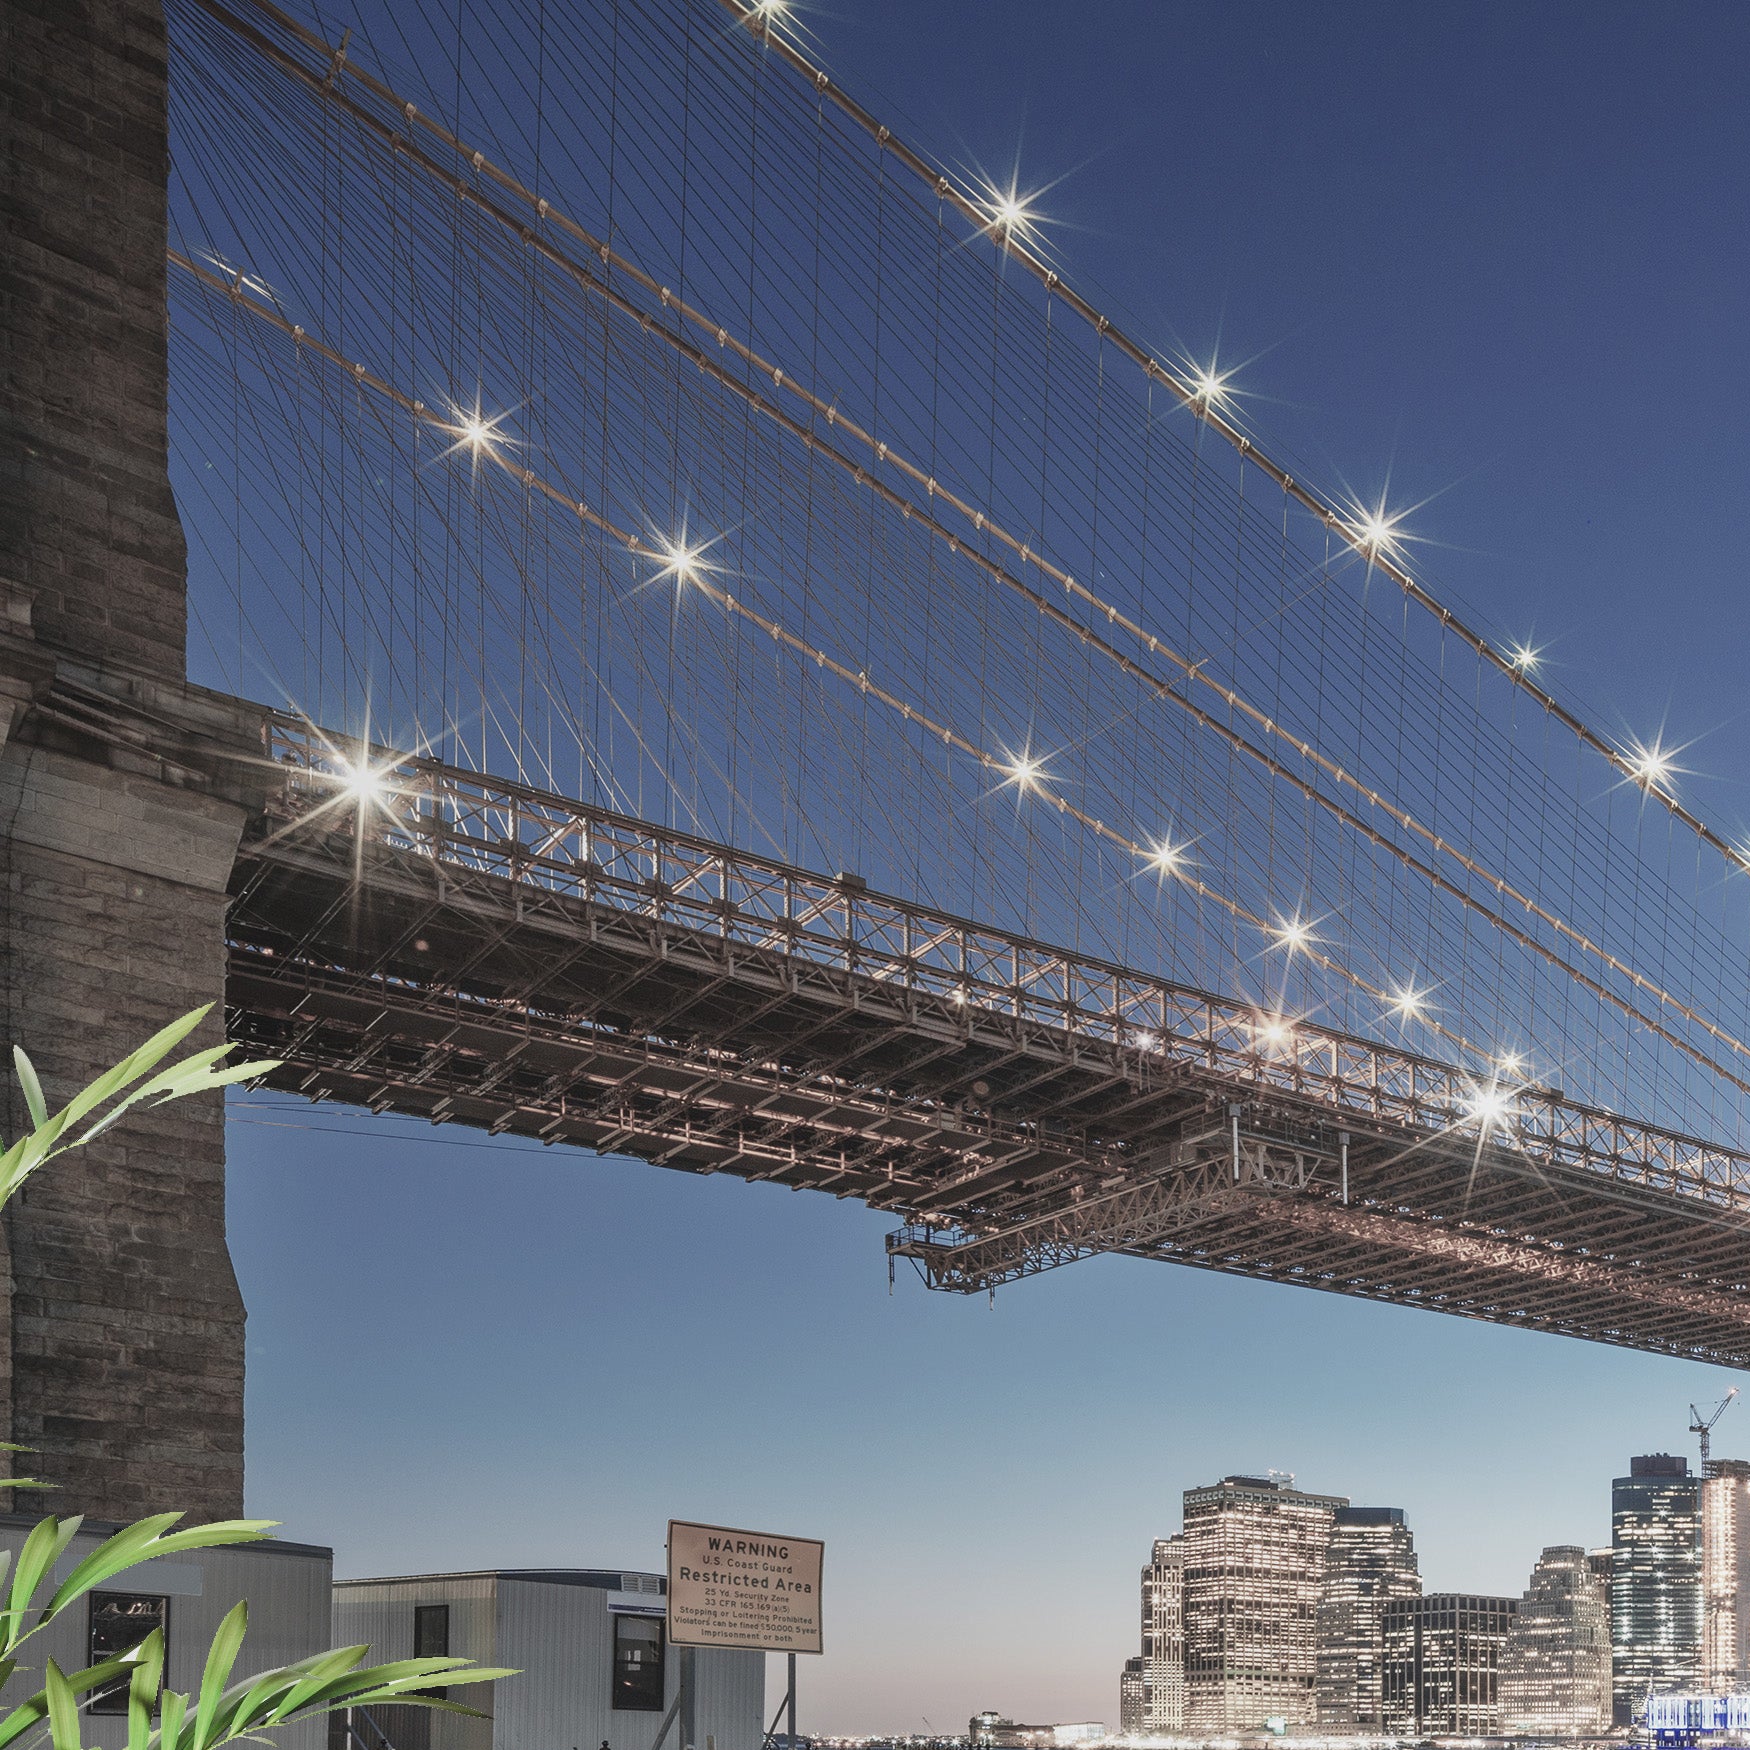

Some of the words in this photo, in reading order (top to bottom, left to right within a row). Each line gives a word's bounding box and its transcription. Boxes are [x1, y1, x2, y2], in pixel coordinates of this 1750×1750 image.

[708, 1537, 789, 1559] WARNING
[702, 1555, 723, 1567] U.S.
[727, 1558, 759, 1570] Coast
[762, 1562, 793, 1574] Guard
[680, 1566, 769, 1589] Restricted
[775, 1578, 812, 1593] Area
[705, 1588, 716, 1596] 25
[735, 1591, 768, 1602] Security
[771, 1595, 790, 1603] Zone
[674, 1616, 710, 1626] Violators
[728, 1620, 737, 1628] be
[740, 1621, 759, 1630] fined
[679, 1606, 717, 1618] Stopping
[733, 1612, 769, 1622] Loitering
[773, 1614, 813, 1624] Prohibited
[701, 1629, 760, 1639] Imprisonment
